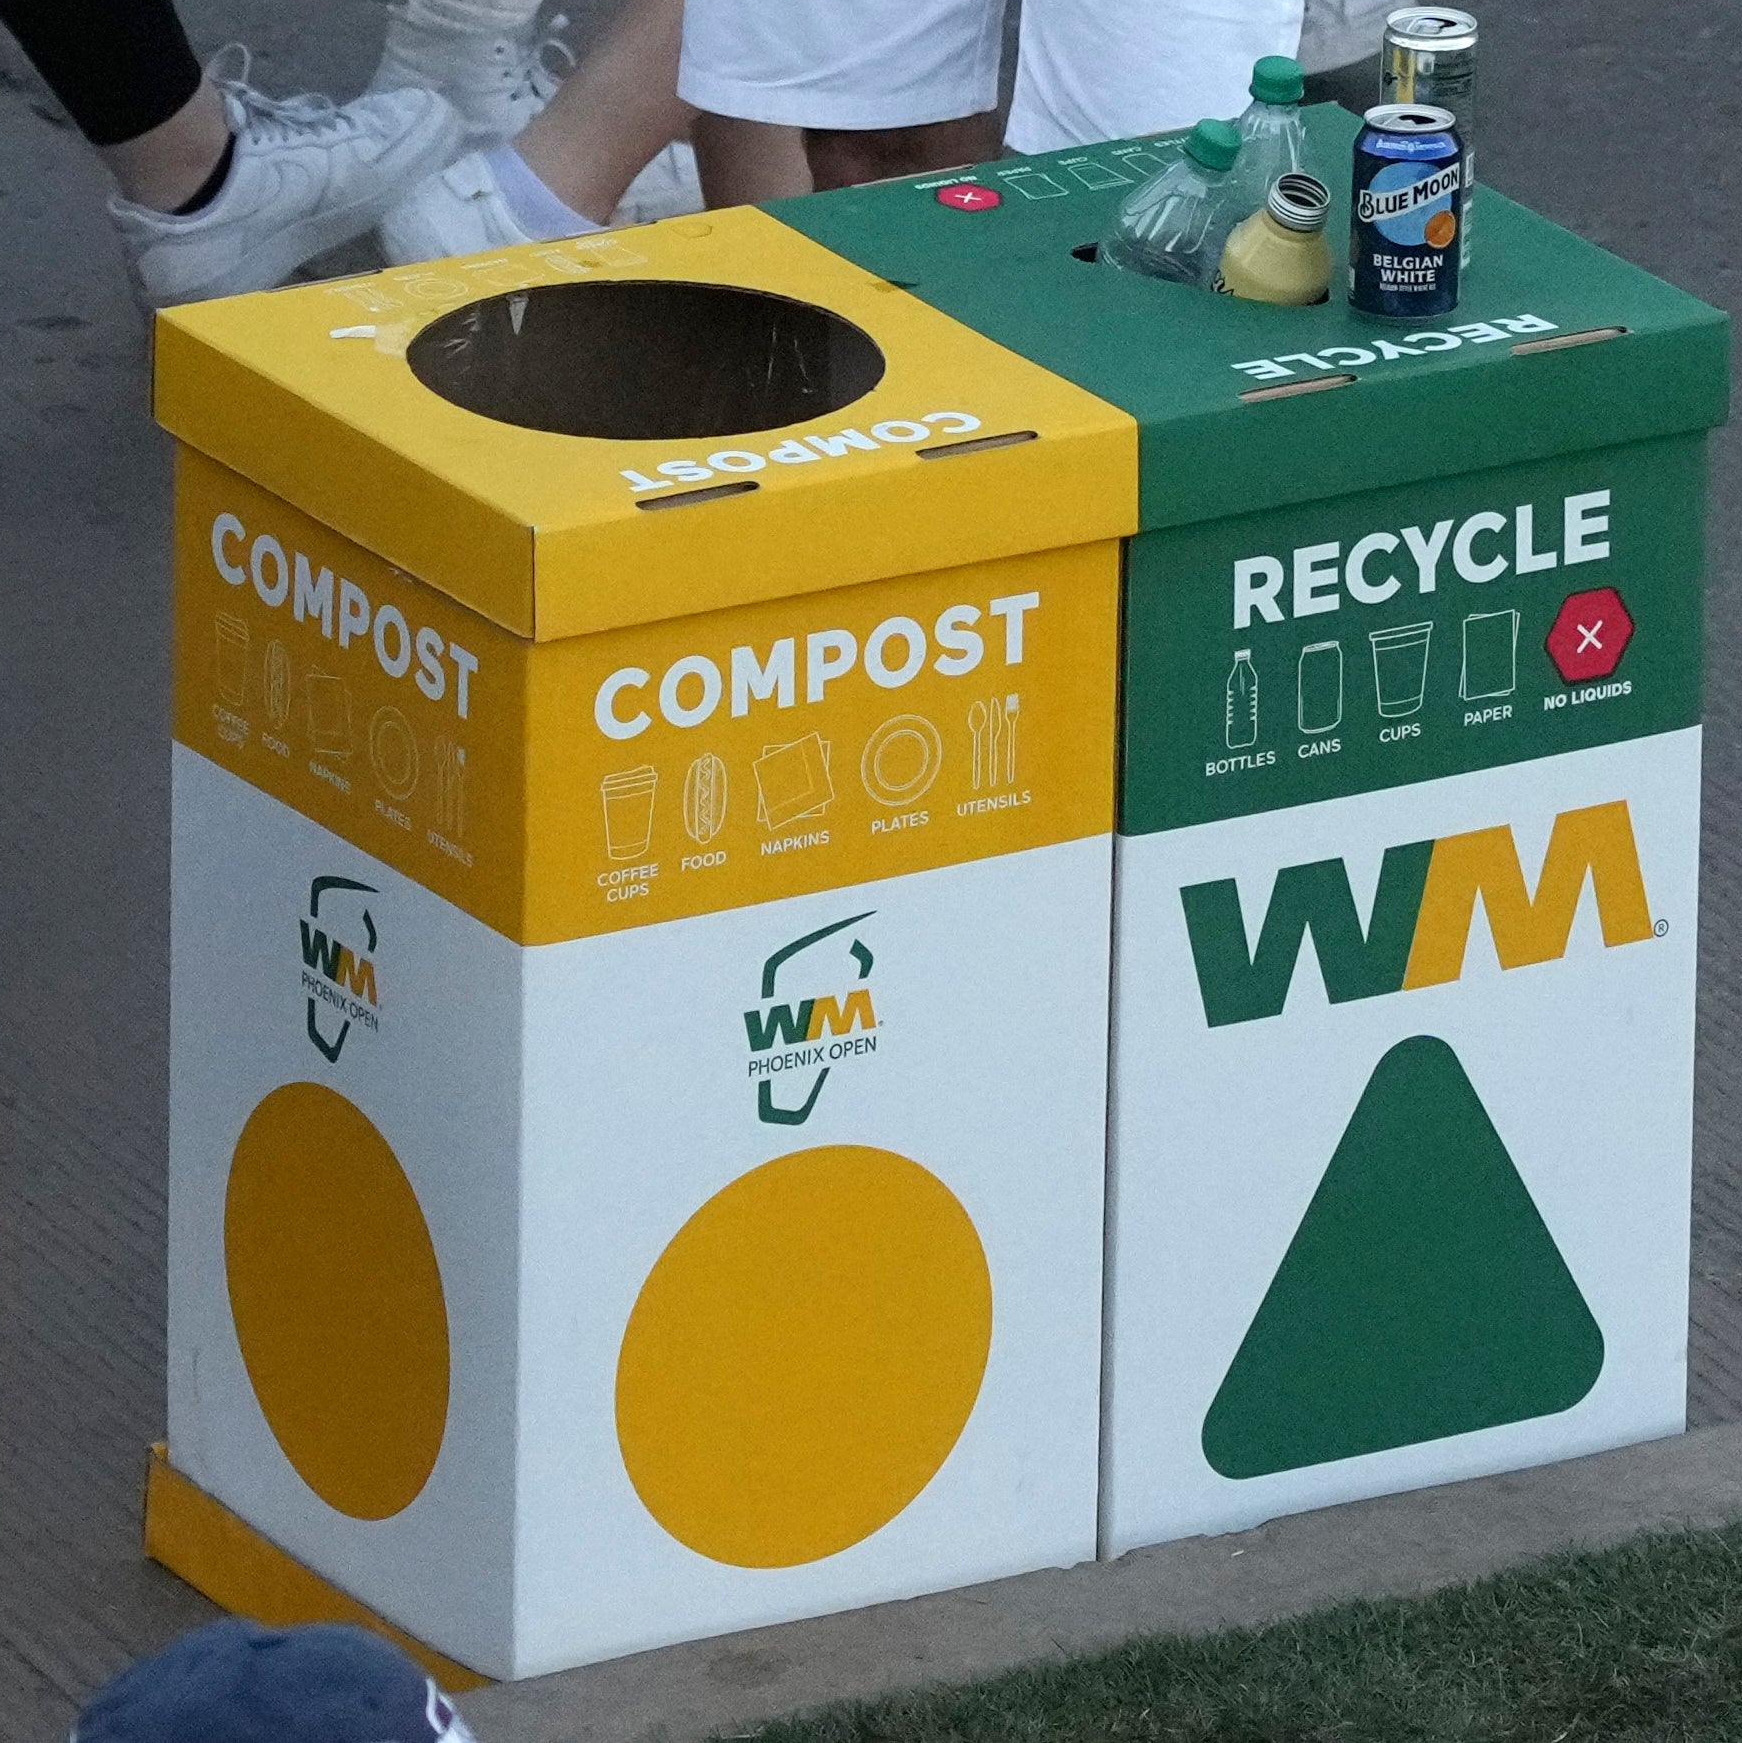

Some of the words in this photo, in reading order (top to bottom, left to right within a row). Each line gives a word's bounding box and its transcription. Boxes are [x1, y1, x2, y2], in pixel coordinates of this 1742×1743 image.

[1360, 191, 1410, 219] BLUE
[1413, 166, 1459, 205] MOON
[1373, 253, 1444, 270] BELGIAN
[1380, 268, 1436, 283] WHITE
[1231, 314, 1559, 380] RECYCLE
[619, 409, 980, 495] COMPOST
[1233, 489, 1612, 631] RECYCLE
[210, 513, 479, 721] COMPOST
[594, 592, 1041, 741] COMPOST
[1543, 692, 1568, 711] NO
[1571, 681, 1633, 708] LIQUIDS
[1463, 704, 1513, 727] PAPER
[1379, 722, 1421, 743] CUPS
[1297, 738, 1342, 759] CANS
[309, 760, 351, 794] NAPKINS
[1205, 751, 1276, 776] BOTTLES
[375, 799, 411, 831] PLATES
[956, 790, 1032, 817] UTENSILS
[871, 810, 930, 834] PLATES
[760, 830, 831, 856] NAPKINS
[680, 850, 727, 872] FOOD
[597, 863, 659, 888] COFFEE
[606, 883, 649, 904] CUPS
[299, 918, 378, 1008] WM
[301, 969, 348, 1013] PHOENIX
[349, 1003, 379, 1033] OPEN
[748, 1046, 825, 1078] PHOENIX
[829, 1035, 877, 1060] OPEN
